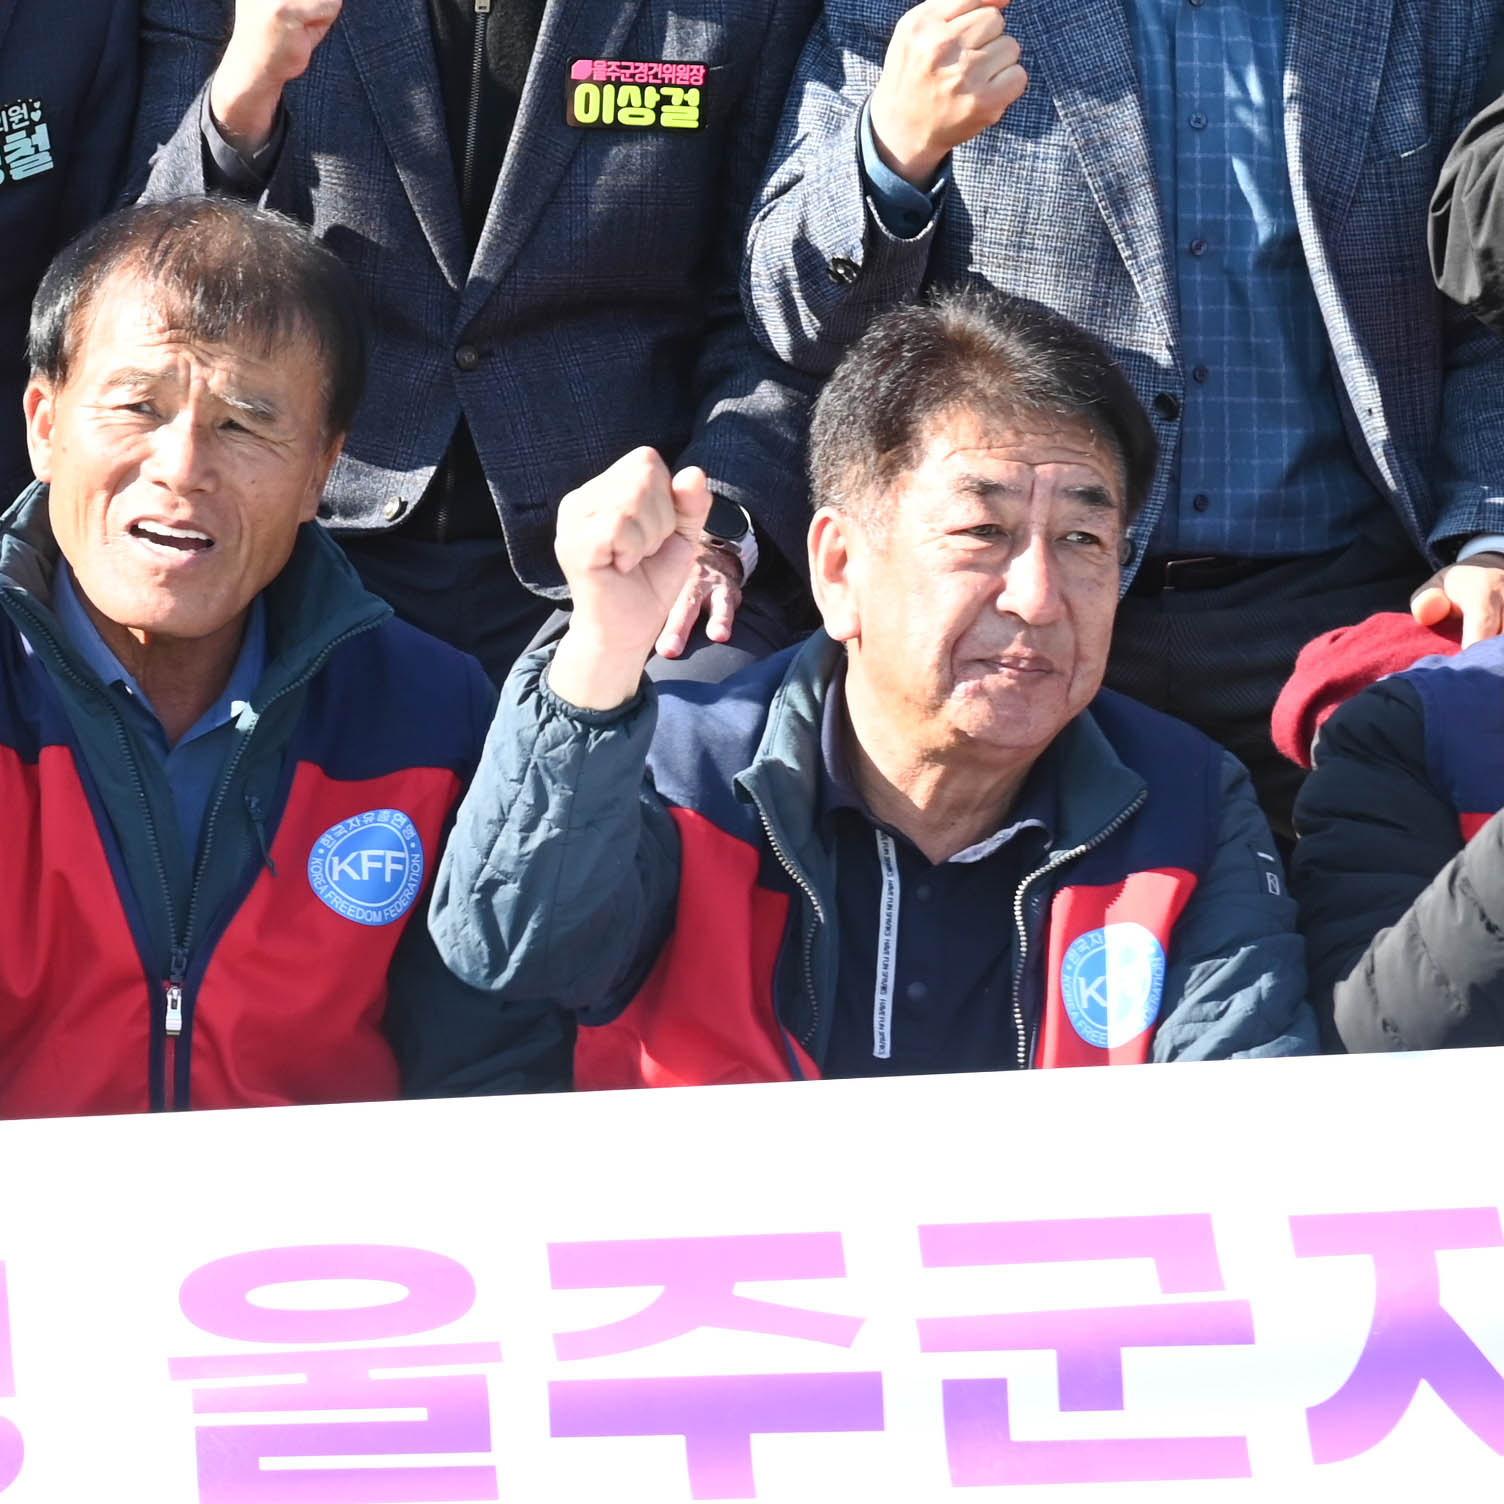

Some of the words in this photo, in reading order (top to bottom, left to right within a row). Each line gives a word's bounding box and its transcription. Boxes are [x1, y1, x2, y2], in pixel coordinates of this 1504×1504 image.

[574, 82, 701, 129] 이상걸
[311, 857, 328, 894] KOREA
[325, 890, 382, 922] FREEDOM
[384, 853, 420, 920] FEDERATION
[332, 849, 406, 883] KFF
